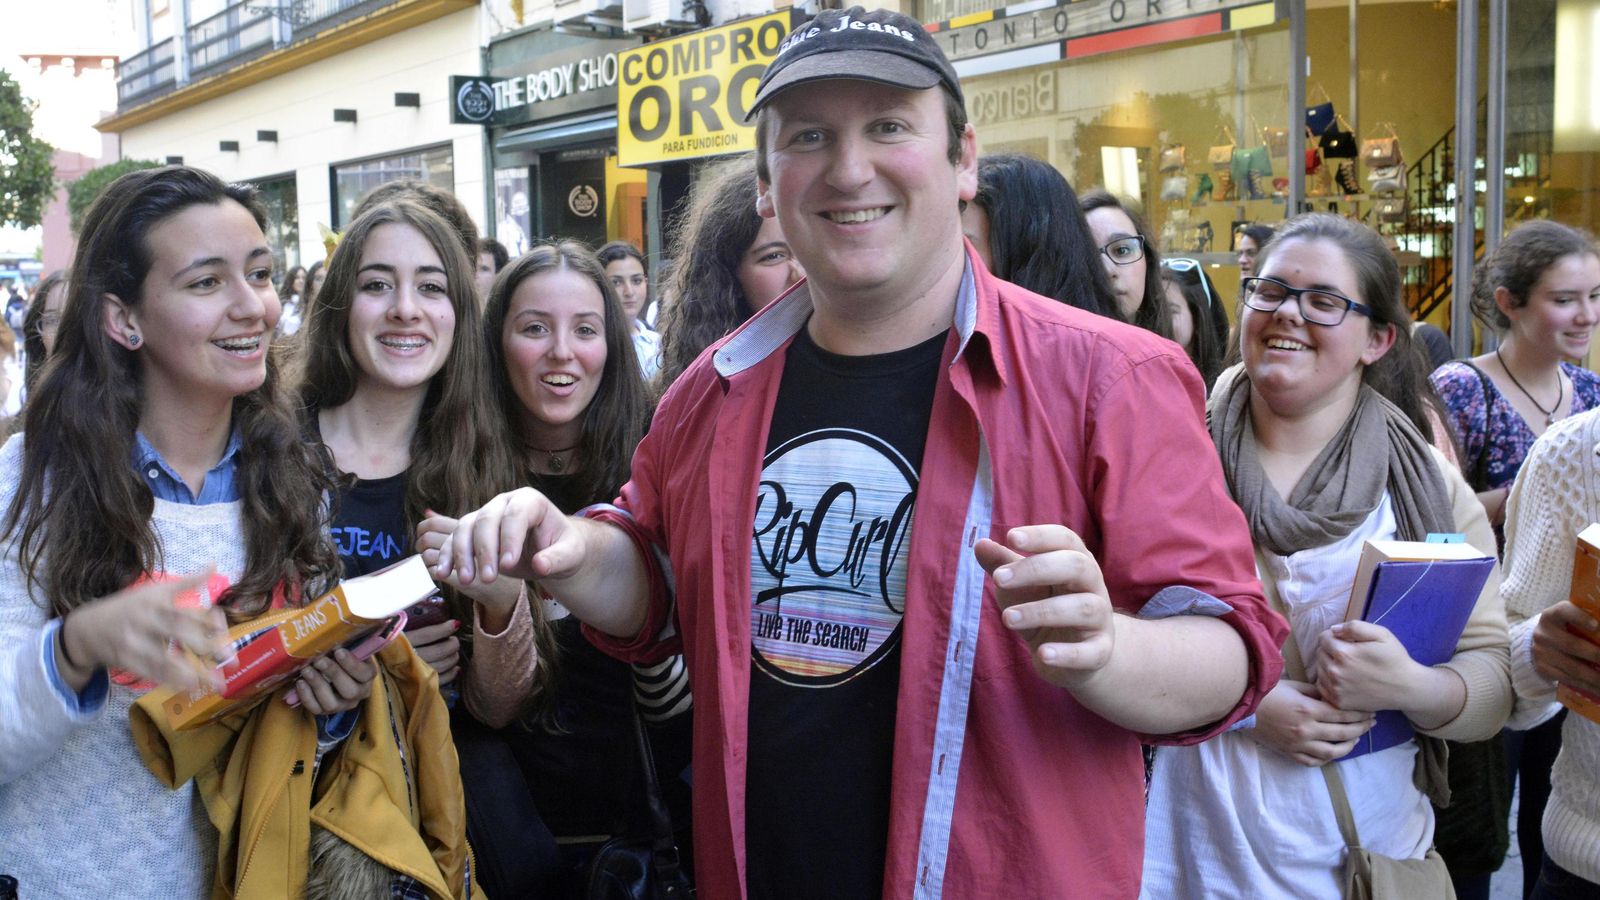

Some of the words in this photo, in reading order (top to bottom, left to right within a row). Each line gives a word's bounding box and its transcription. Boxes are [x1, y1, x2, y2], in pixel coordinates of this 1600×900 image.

[829, 15, 915, 42] Jeans
[623, 19, 786, 86] COMPRO
[491, 77, 525, 111] THE
[526, 63, 575, 104] BODY
[662, 141, 684, 154] PARA
[687, 133, 738, 151] FUNDICION
[292, 605, 328, 641] JEANS
